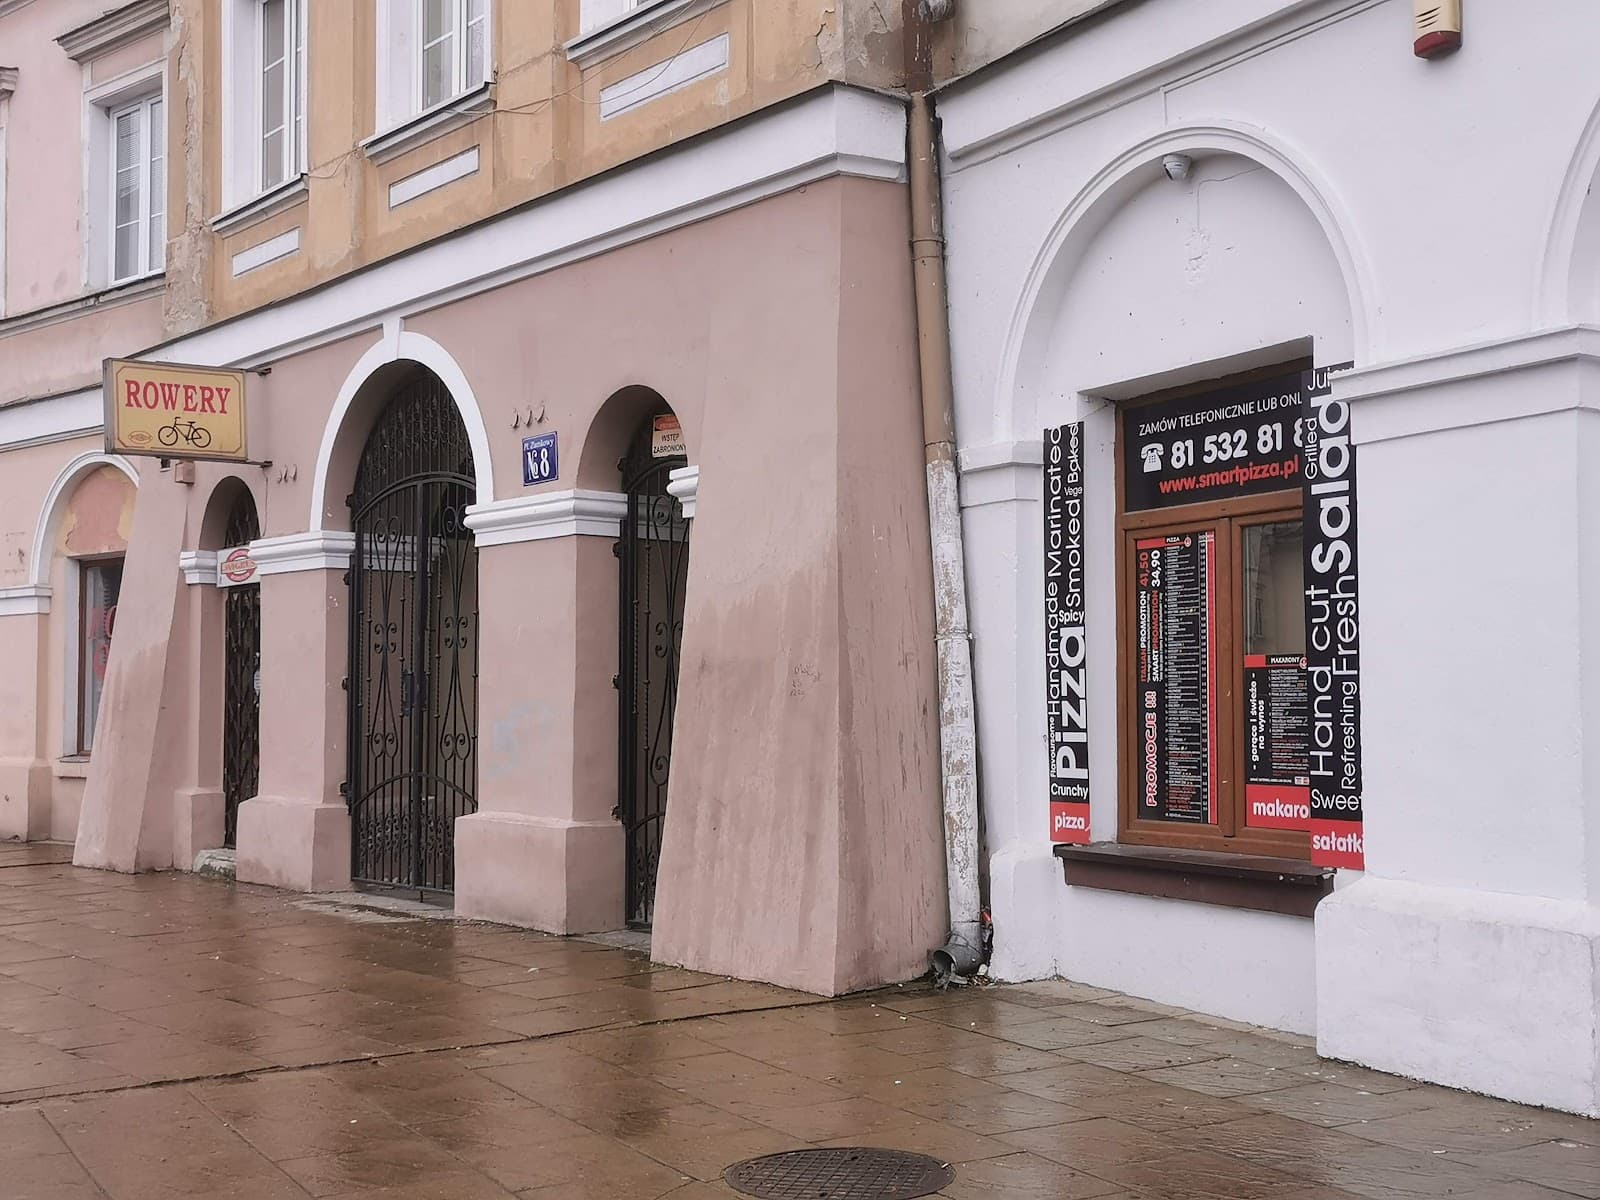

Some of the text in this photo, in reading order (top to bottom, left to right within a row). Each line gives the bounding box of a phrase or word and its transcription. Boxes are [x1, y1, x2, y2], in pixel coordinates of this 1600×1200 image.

[125, 380, 231, 414] ROWERY
[1139, 417, 1178, 436] ZAMÓW
[1179, 402, 1255, 427] TELEFONICZNIE
[1257, 397, 1278, 413] LUB
[540, 448, 550, 478] 8
[1067, 422, 1081, 483] Baked
[1171, 439, 1194, 469] 81
[1203, 429, 1249, 464] 532
[1257, 422, 1283, 454] 81
[1305, 417, 1318, 480] Grilled
[1159, 454, 1299, 494] www.smartpizza.pl
[1065, 499, 1081, 608] Smoked
[1139, 551, 1150, 588] 41,50
[1151, 550, 1162, 588] 34,90
[1059, 609, 1085, 625] Spicy
[1331, 575, 1358, 676] Fresh
[1046, 581, 1060, 715] Handmade
[1305, 584, 1334, 777] Hand cut
[1056, 626, 1088, 780] Pizza
[1257, 699, 1266, 750] na wynos
[1340, 681, 1358, 790] Refreshing
[1145, 711, 1158, 807] PROMOCJE
[1051, 782, 1088, 800] Crunchy
[1253, 798, 1310, 819] makaro
[1311, 788, 1362, 811] Swee
[1054, 812, 1085, 833] pizza
[1312, 830, 1363, 853] sałatk
